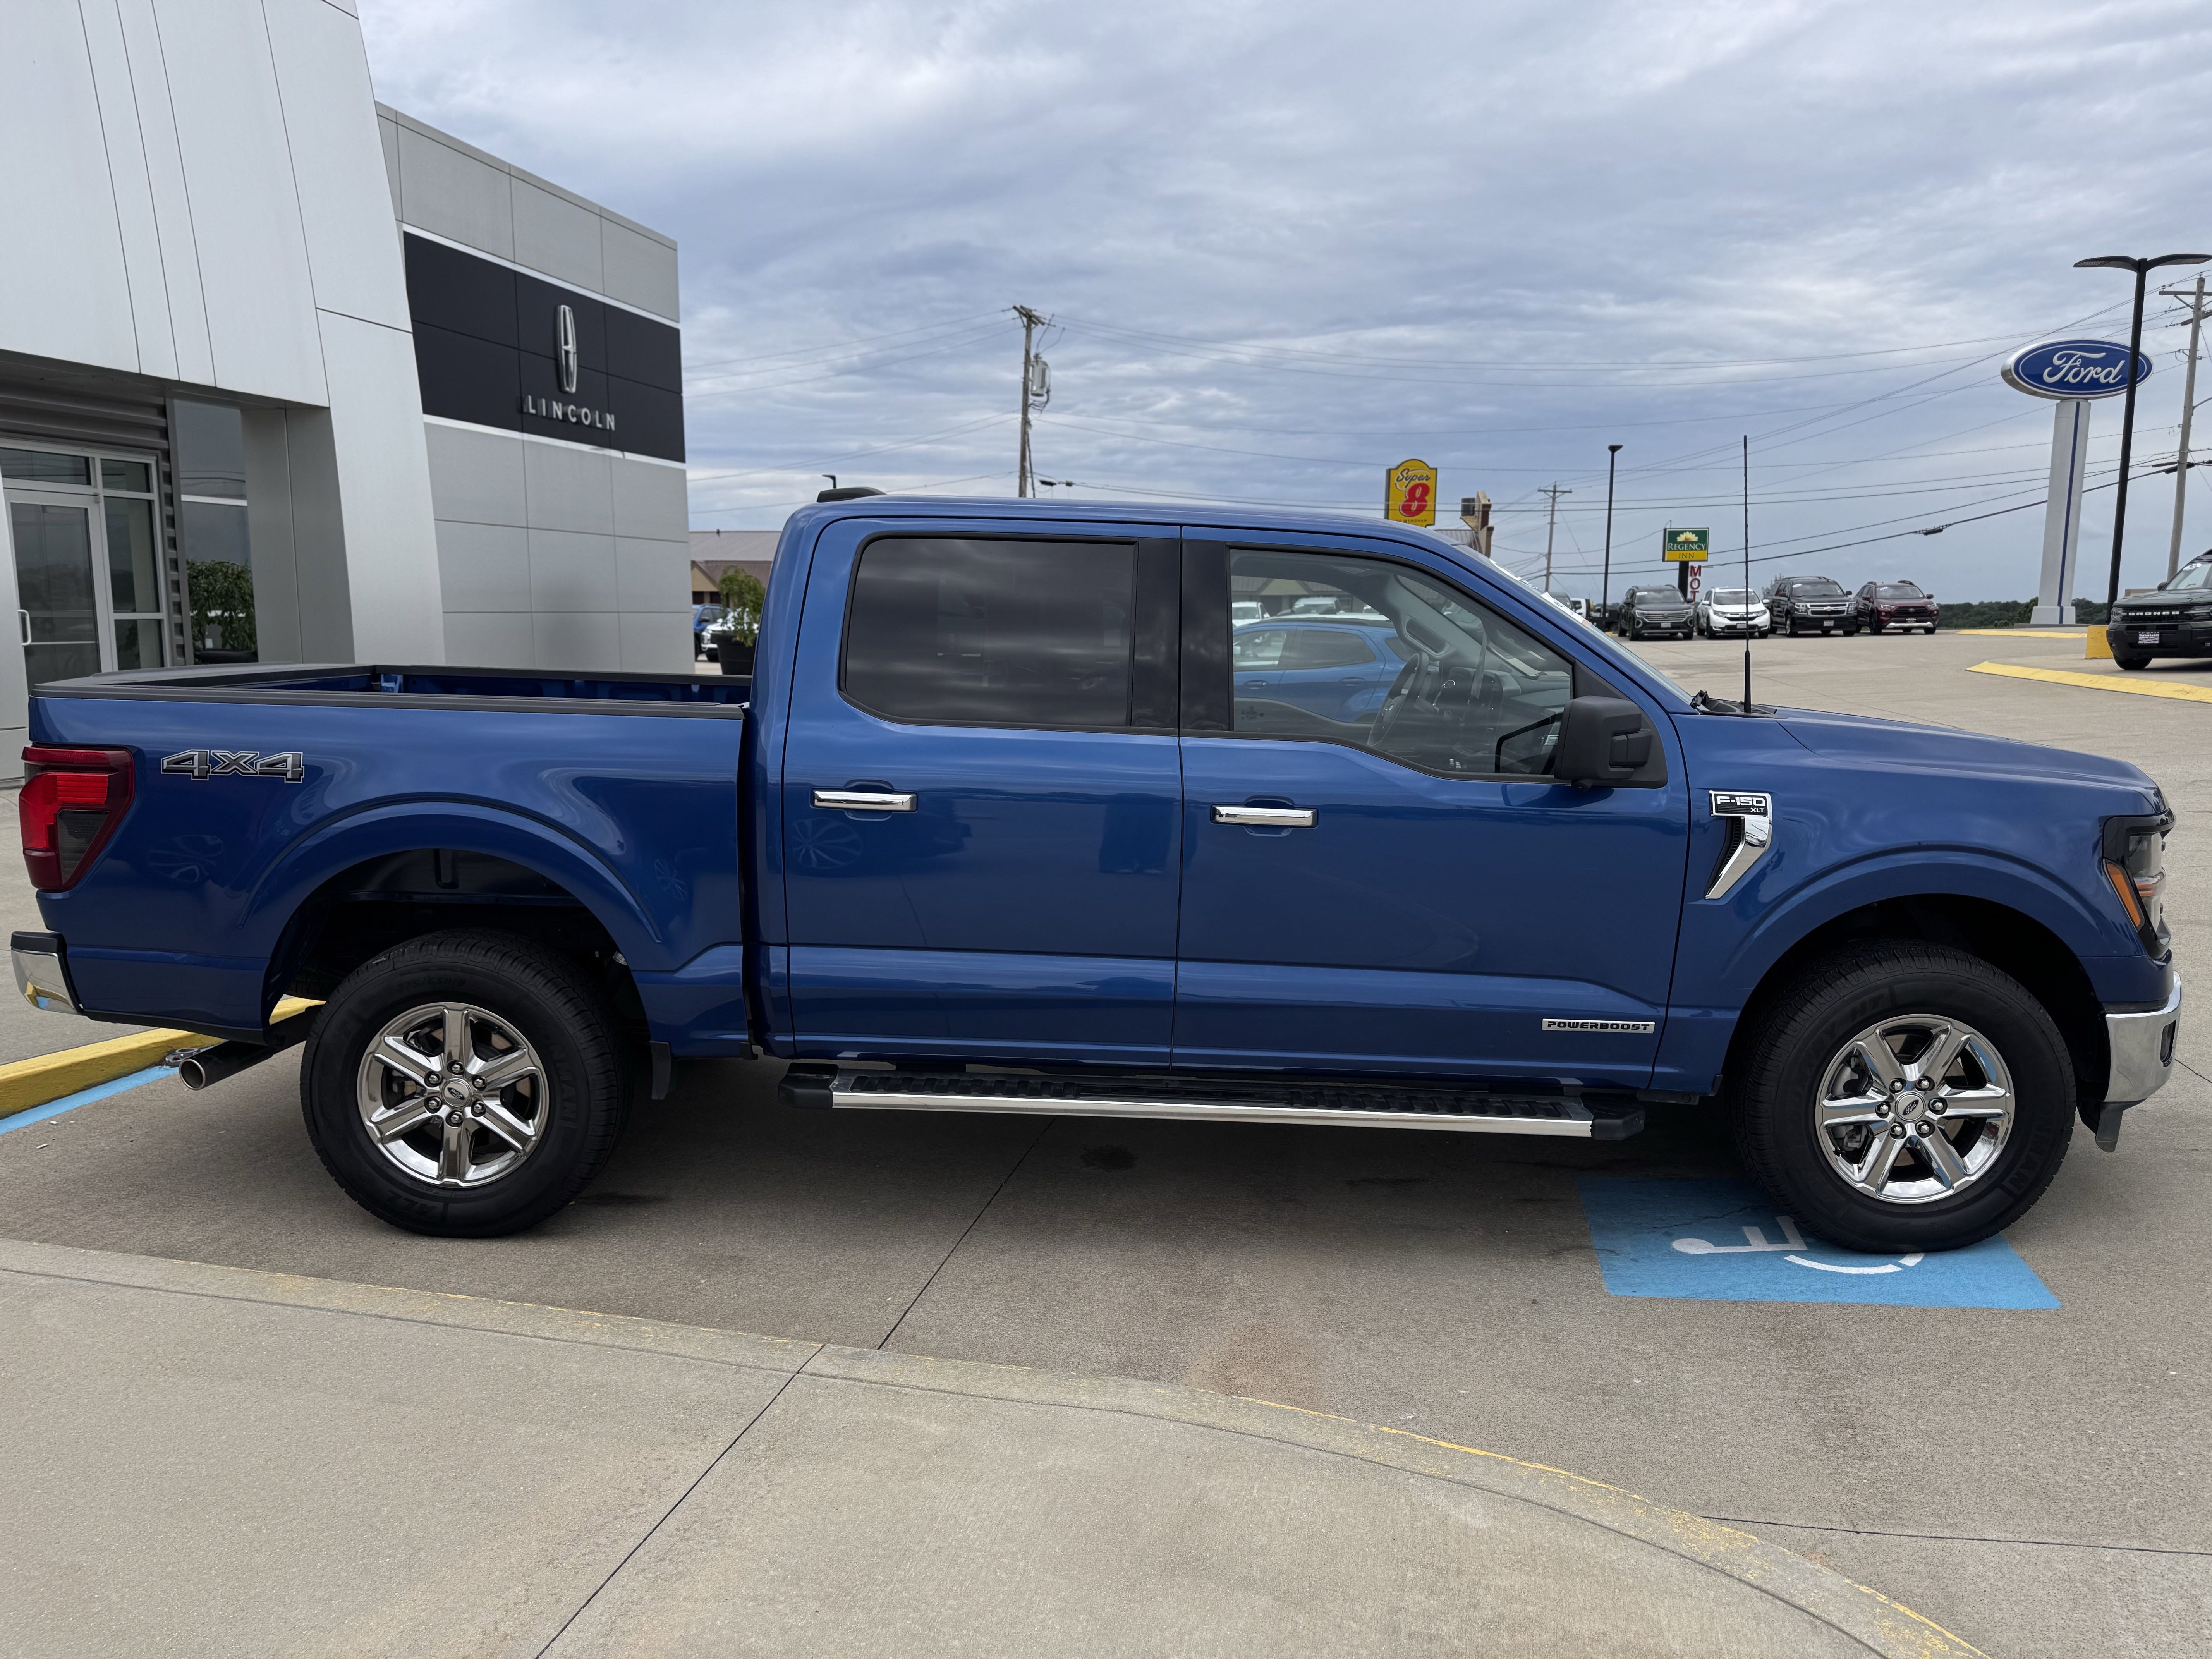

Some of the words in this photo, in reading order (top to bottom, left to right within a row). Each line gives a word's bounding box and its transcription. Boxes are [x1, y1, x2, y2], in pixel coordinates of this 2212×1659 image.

[2043, 350, 2126, 383] Ford
[527, 395, 615, 431] LINCOLN
[1396, 468, 1431, 488] Super
[1399, 483, 1430, 517] 8
[1716, 795, 1766, 807] F-150
[1547, 1020, 1650, 1031] POWERBOOST
[1905, 1101, 1917, 1114] Ford
